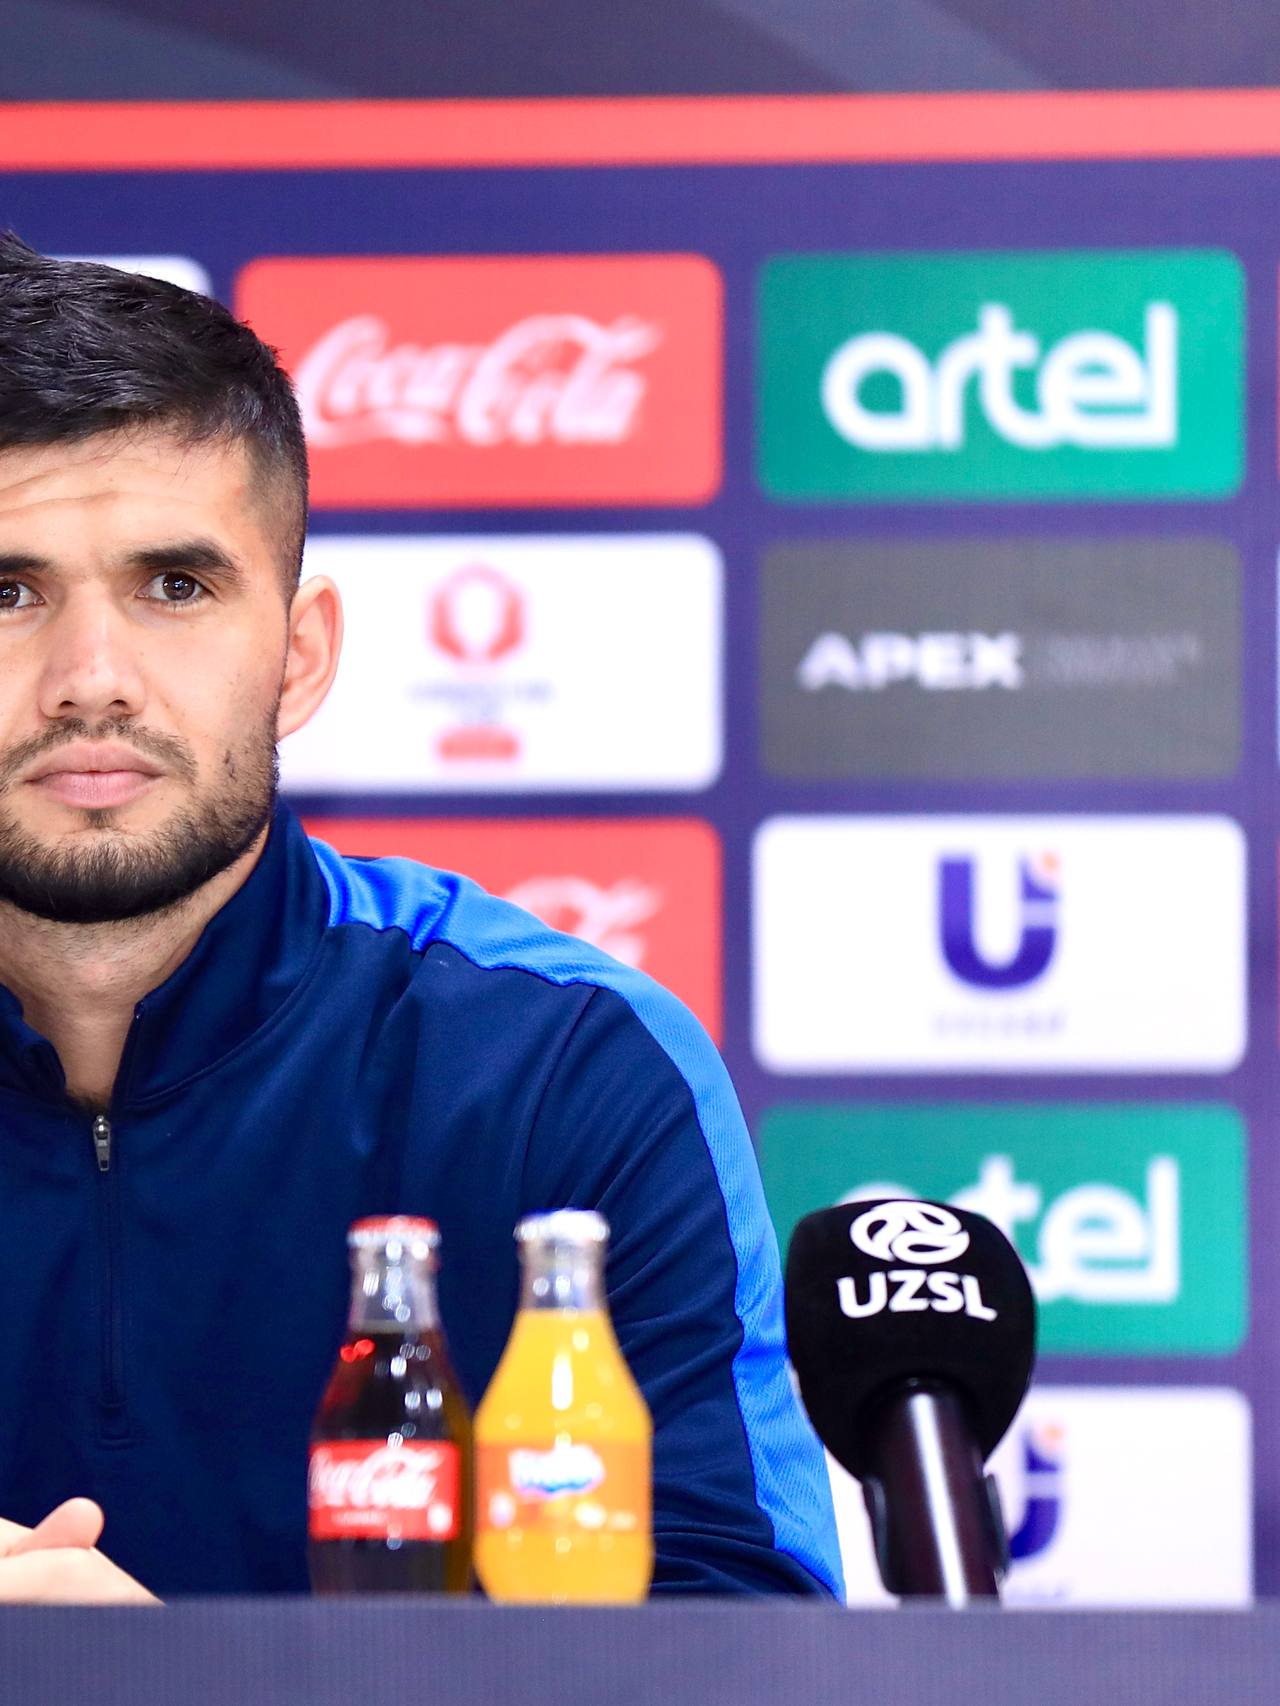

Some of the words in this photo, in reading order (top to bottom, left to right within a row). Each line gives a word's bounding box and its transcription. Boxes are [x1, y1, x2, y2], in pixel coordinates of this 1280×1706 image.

[822, 300, 1178, 452] artel
[798, 632, 1024, 691] APEX
[835, 1154, 1179, 1305] tel
[837, 1270, 998, 1322] UZSL
